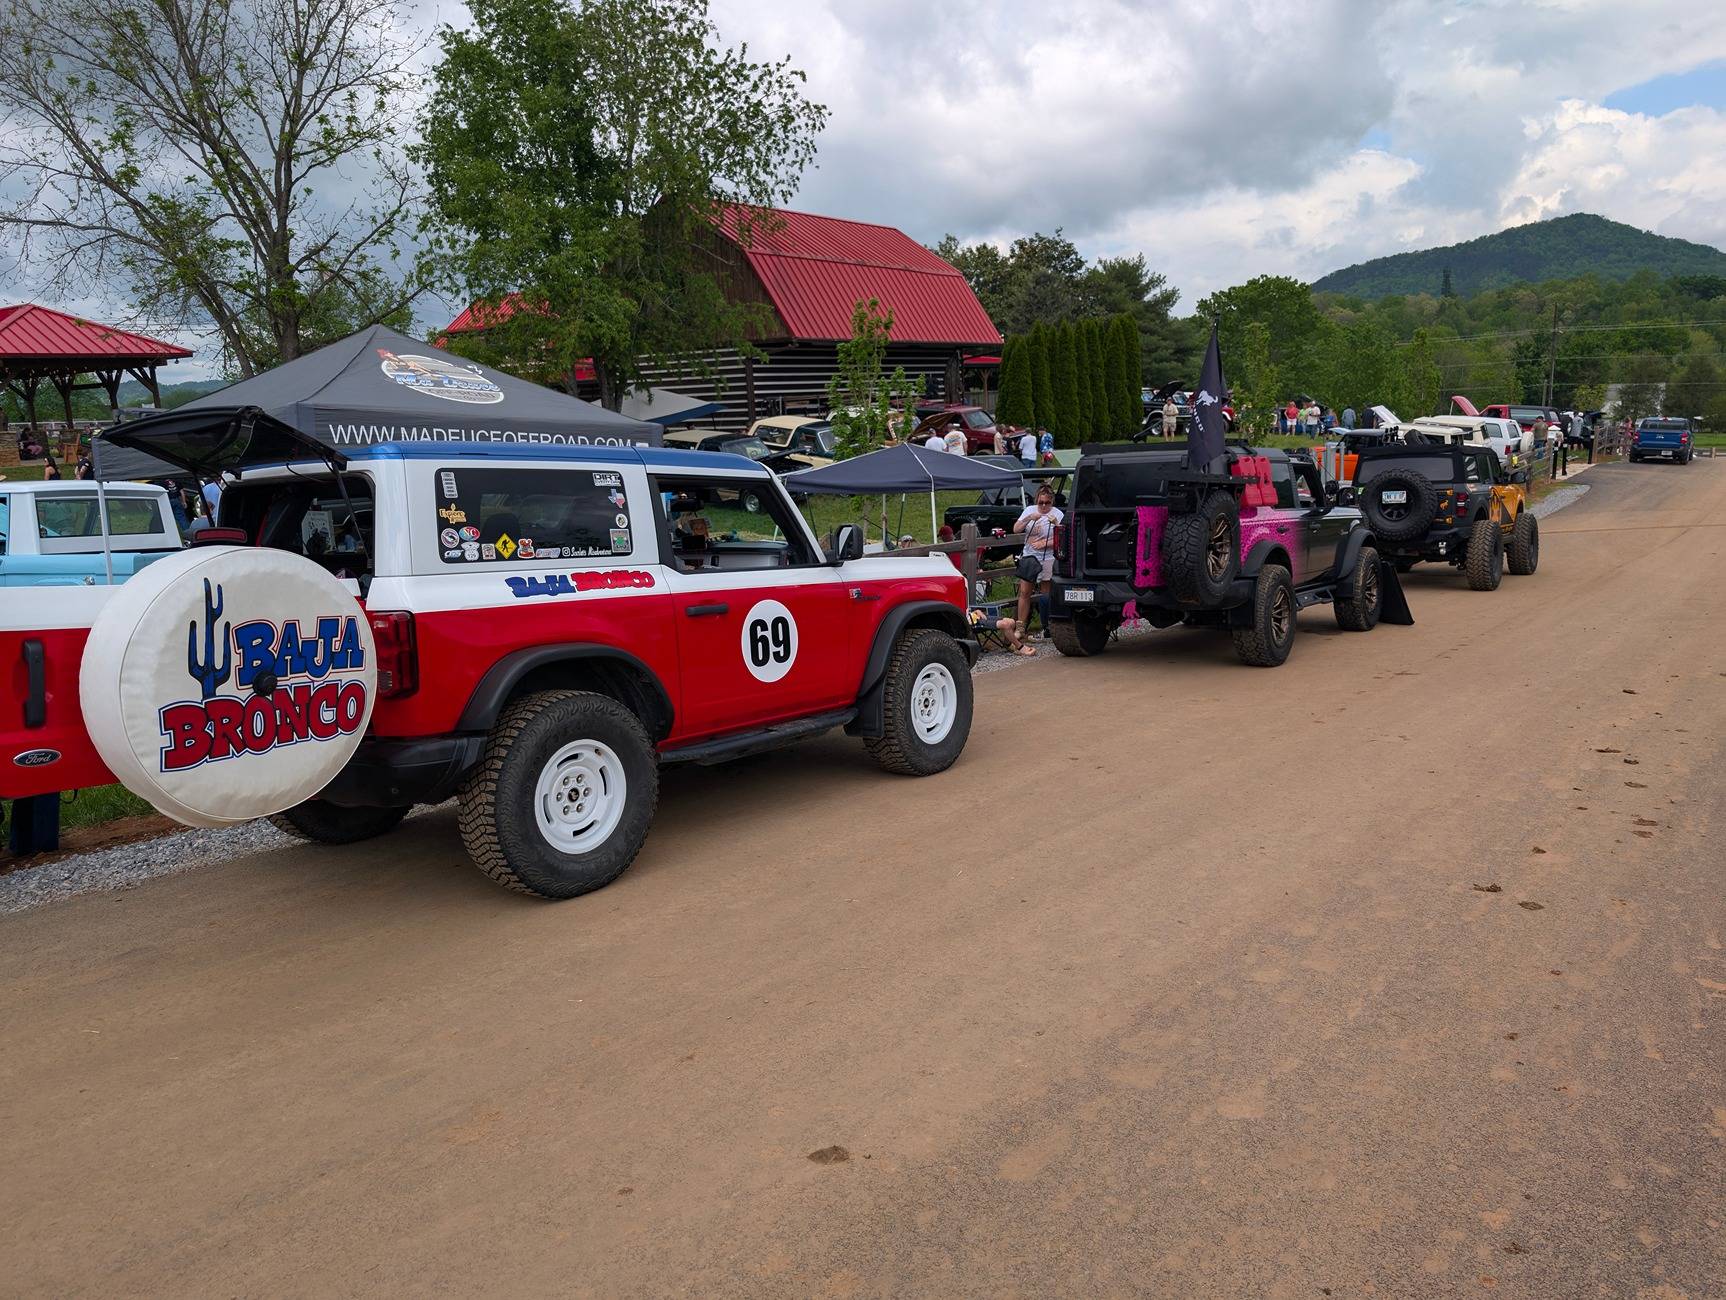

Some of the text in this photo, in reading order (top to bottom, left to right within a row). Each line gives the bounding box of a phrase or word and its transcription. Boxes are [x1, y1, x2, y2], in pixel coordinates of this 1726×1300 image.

[505, 570, 655, 598] BAJA BRONCO
[232, 616, 365, 690] BAJA
[749, 616, 791, 667] 69
[158, 680, 367, 773] BRONCO
[26, 752, 52, 764] Ford
